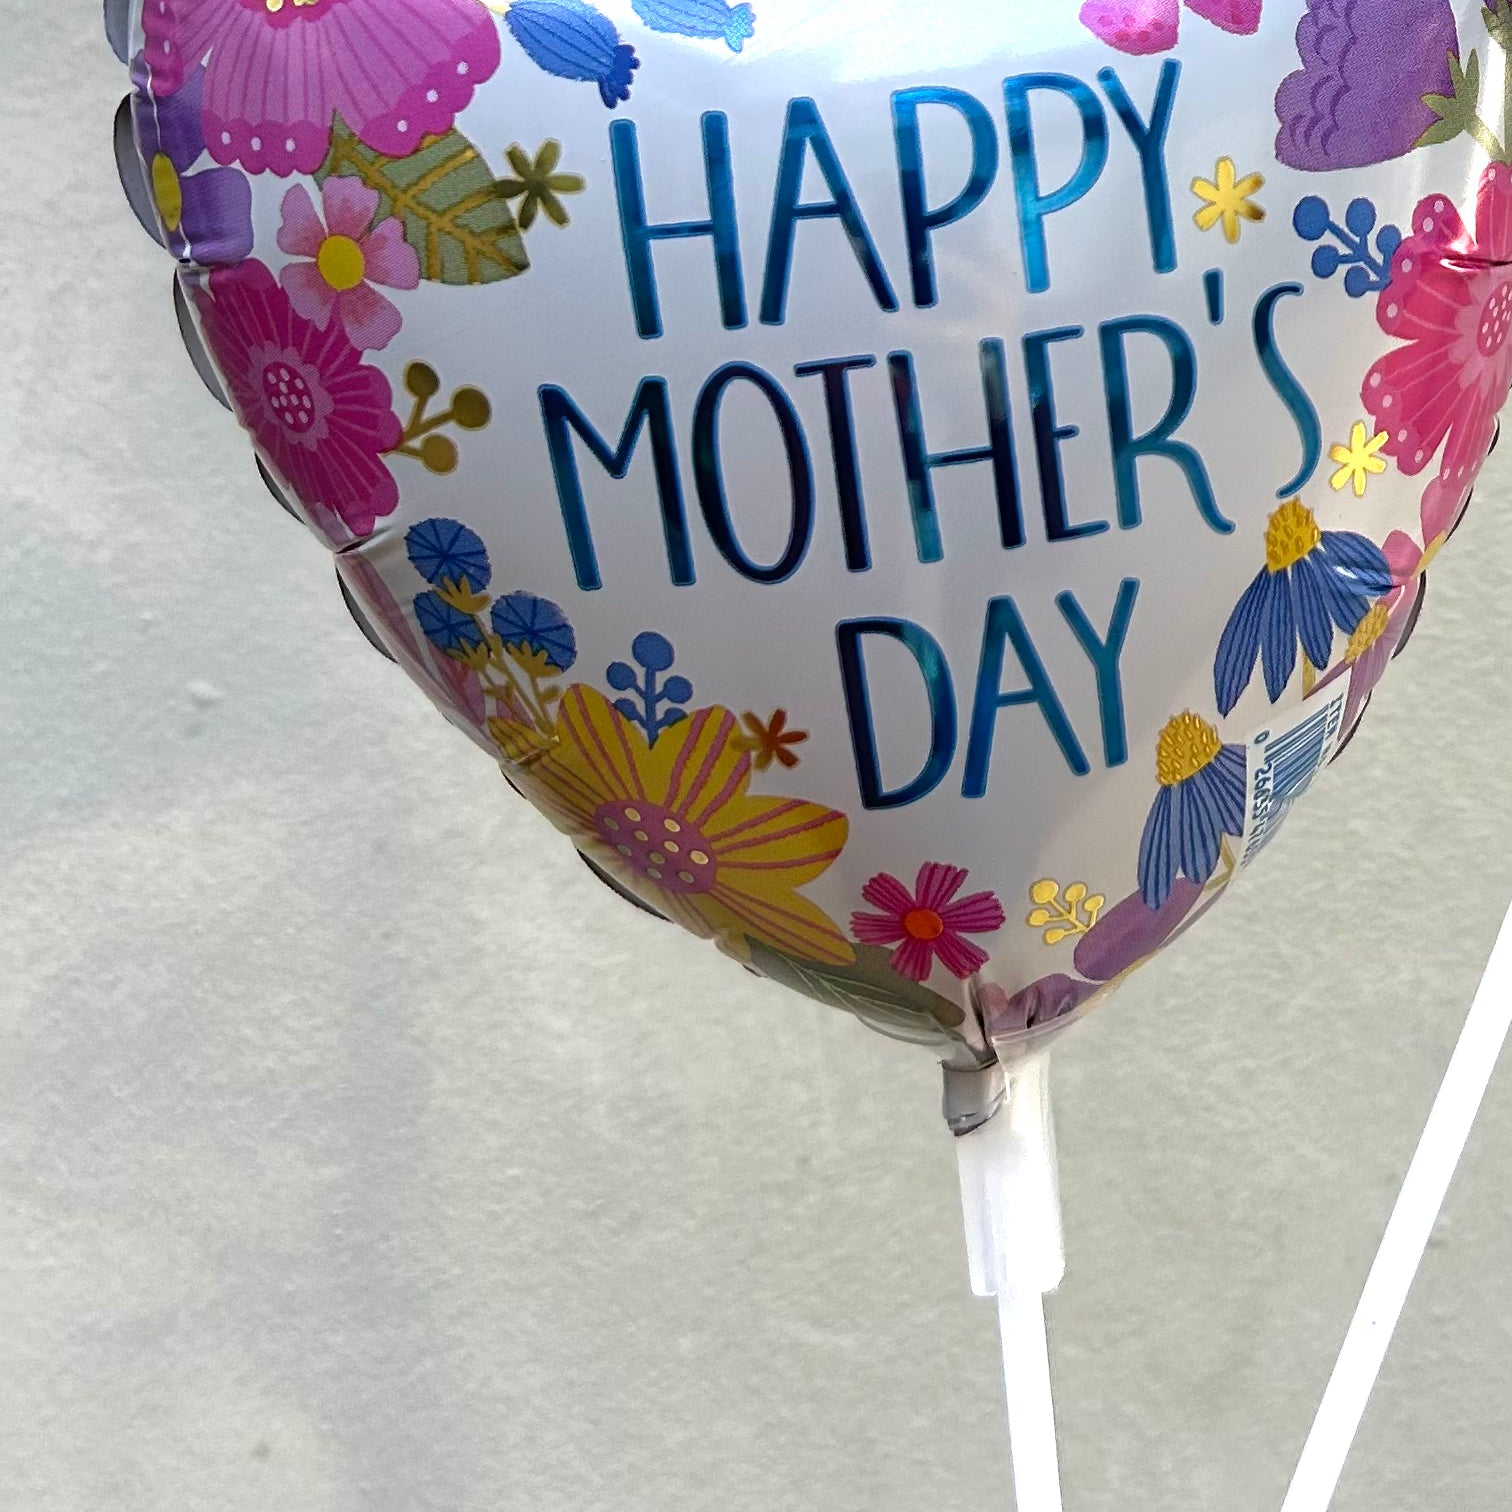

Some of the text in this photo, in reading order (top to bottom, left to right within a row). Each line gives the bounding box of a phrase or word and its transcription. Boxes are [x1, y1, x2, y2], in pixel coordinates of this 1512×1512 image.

[608, 58, 1181, 339] HAPPY
[538, 268, 1322, 591] MOTHER'S
[835, 577, 1140, 809] DAY
